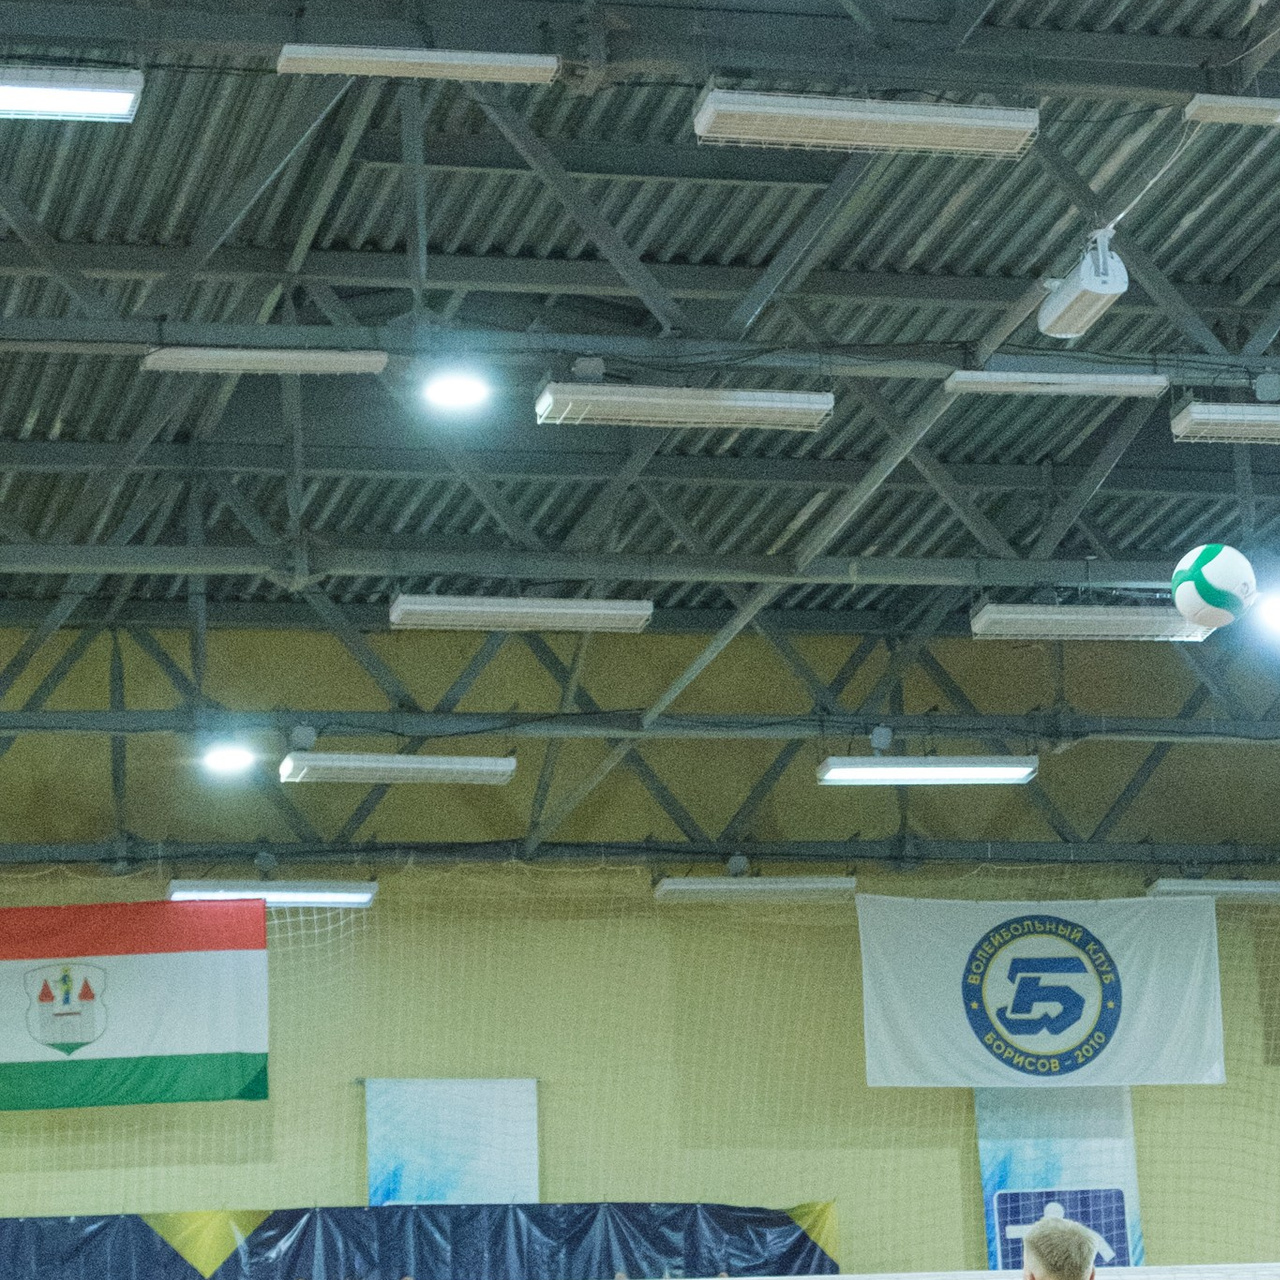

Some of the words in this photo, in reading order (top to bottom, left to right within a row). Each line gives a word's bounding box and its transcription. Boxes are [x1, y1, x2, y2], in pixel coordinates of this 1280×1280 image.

[968, 920, 1083, 985] ВОЛЕЙБОЛЬНЫЙ
[1085, 942, 1115, 984] КЛУБ
[984, 1031, 1060, 1072] БОРИСОВ
[1074, 1031, 1106, 1064] 2010
